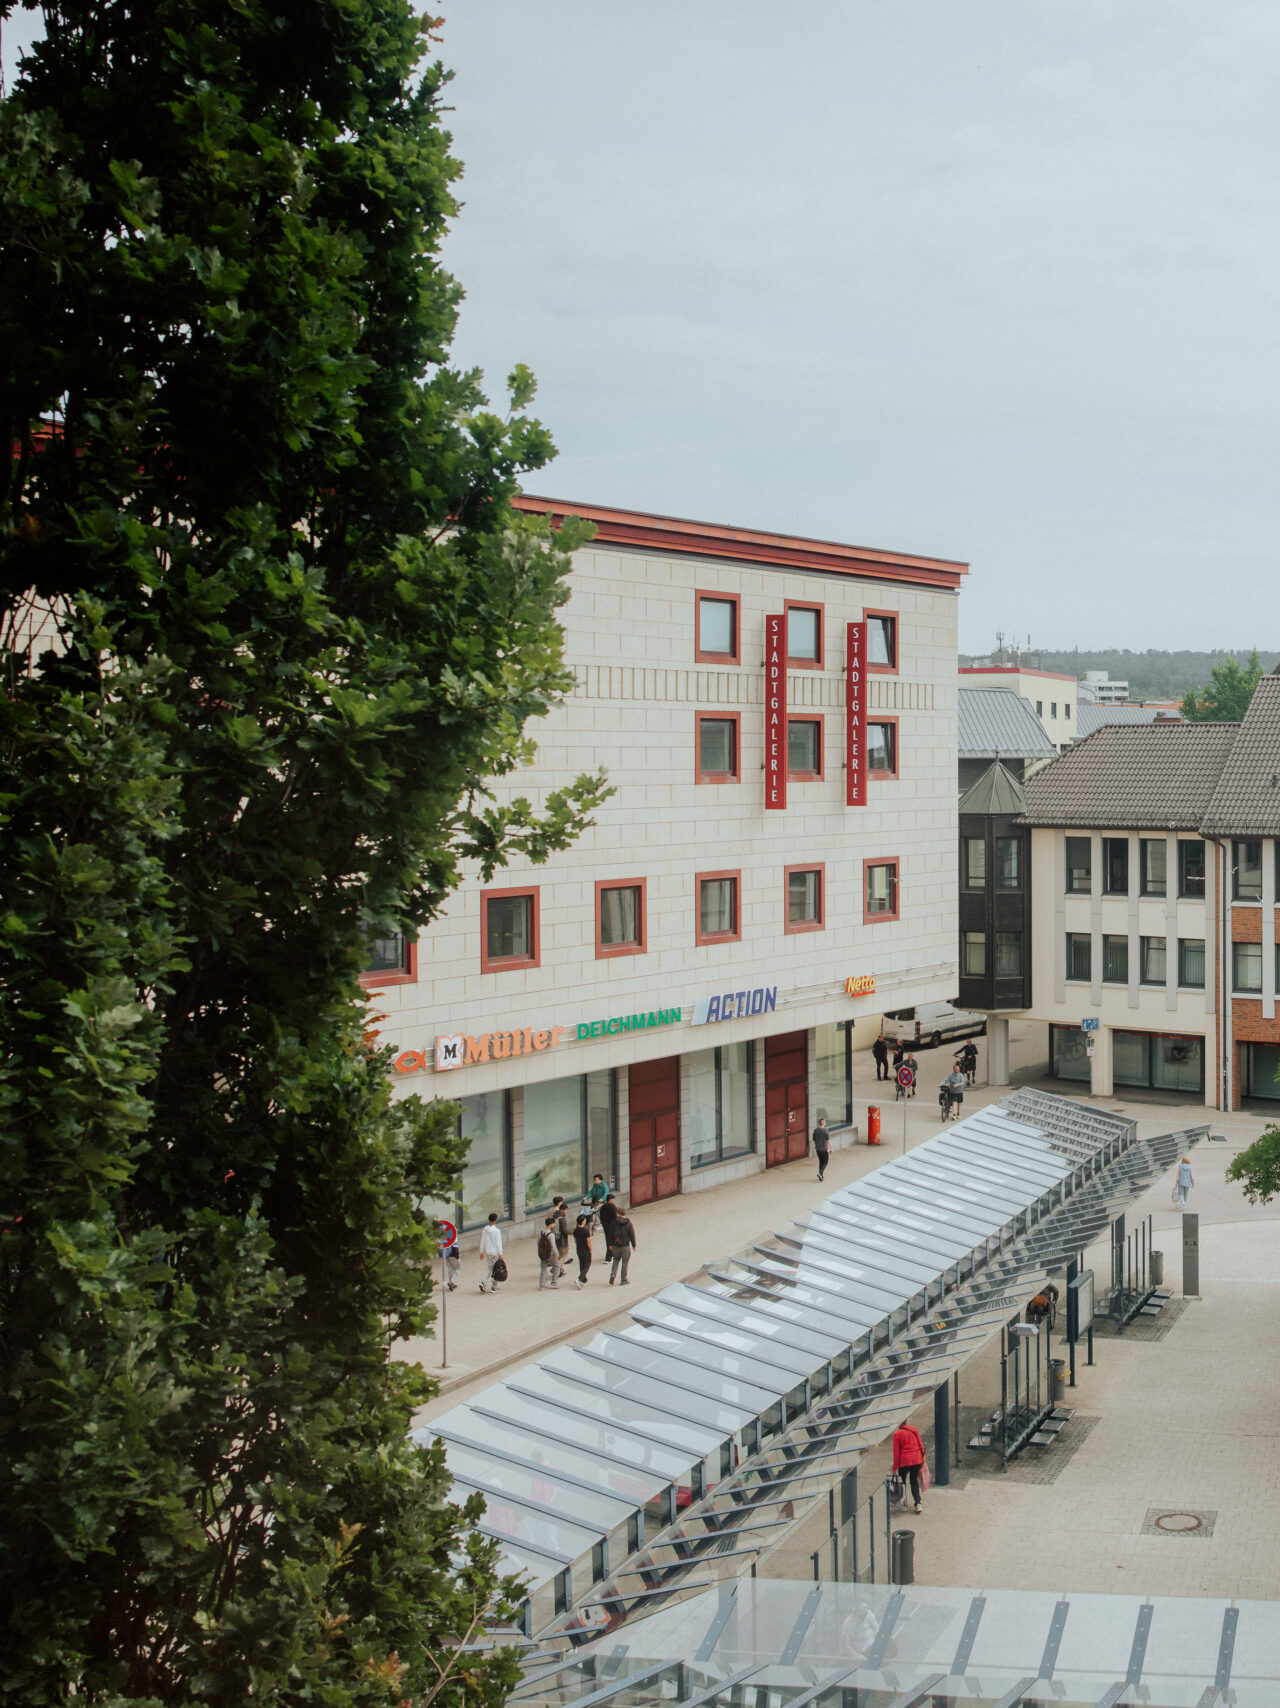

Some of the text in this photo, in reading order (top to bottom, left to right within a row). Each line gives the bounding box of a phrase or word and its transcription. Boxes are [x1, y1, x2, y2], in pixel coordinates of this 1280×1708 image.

[771, 619, 779, 802] STADTGALERIE
[852, 627, 860, 799] STADTGALERIE
[846, 975, 876, 992] Netto
[577, 1007, 682, 1040] DEICHMANN
[706, 986, 778, 1023] ACTION
[444, 1025, 565, 1064] M Müller
